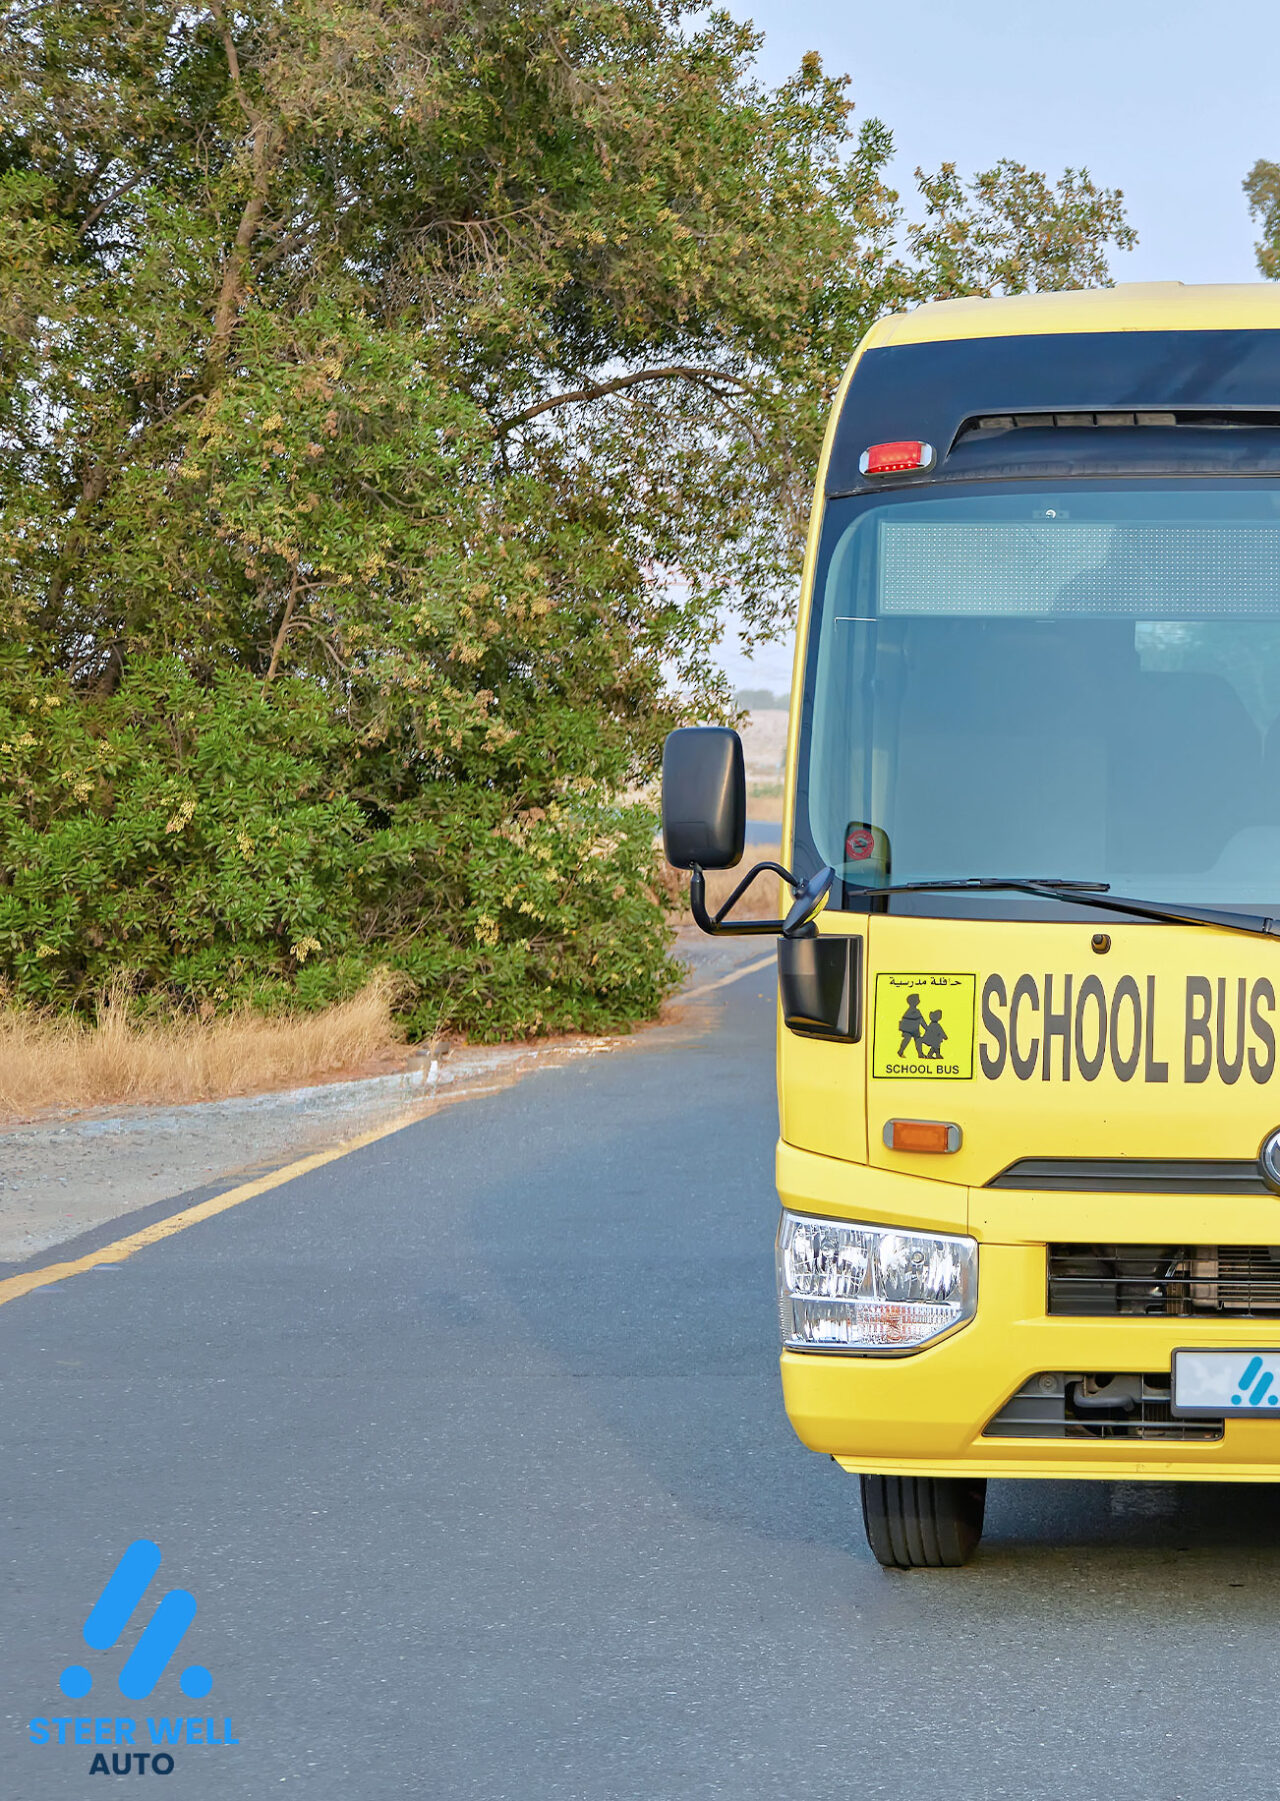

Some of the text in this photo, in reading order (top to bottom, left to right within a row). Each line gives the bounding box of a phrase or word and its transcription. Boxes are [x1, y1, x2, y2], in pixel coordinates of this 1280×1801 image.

[889, 976, 962, 988] حافلة مدرسية
[979, 973, 1276, 1085] SCHOOL BUS
[885, 1064, 959, 1074] SCHOOL BUS
